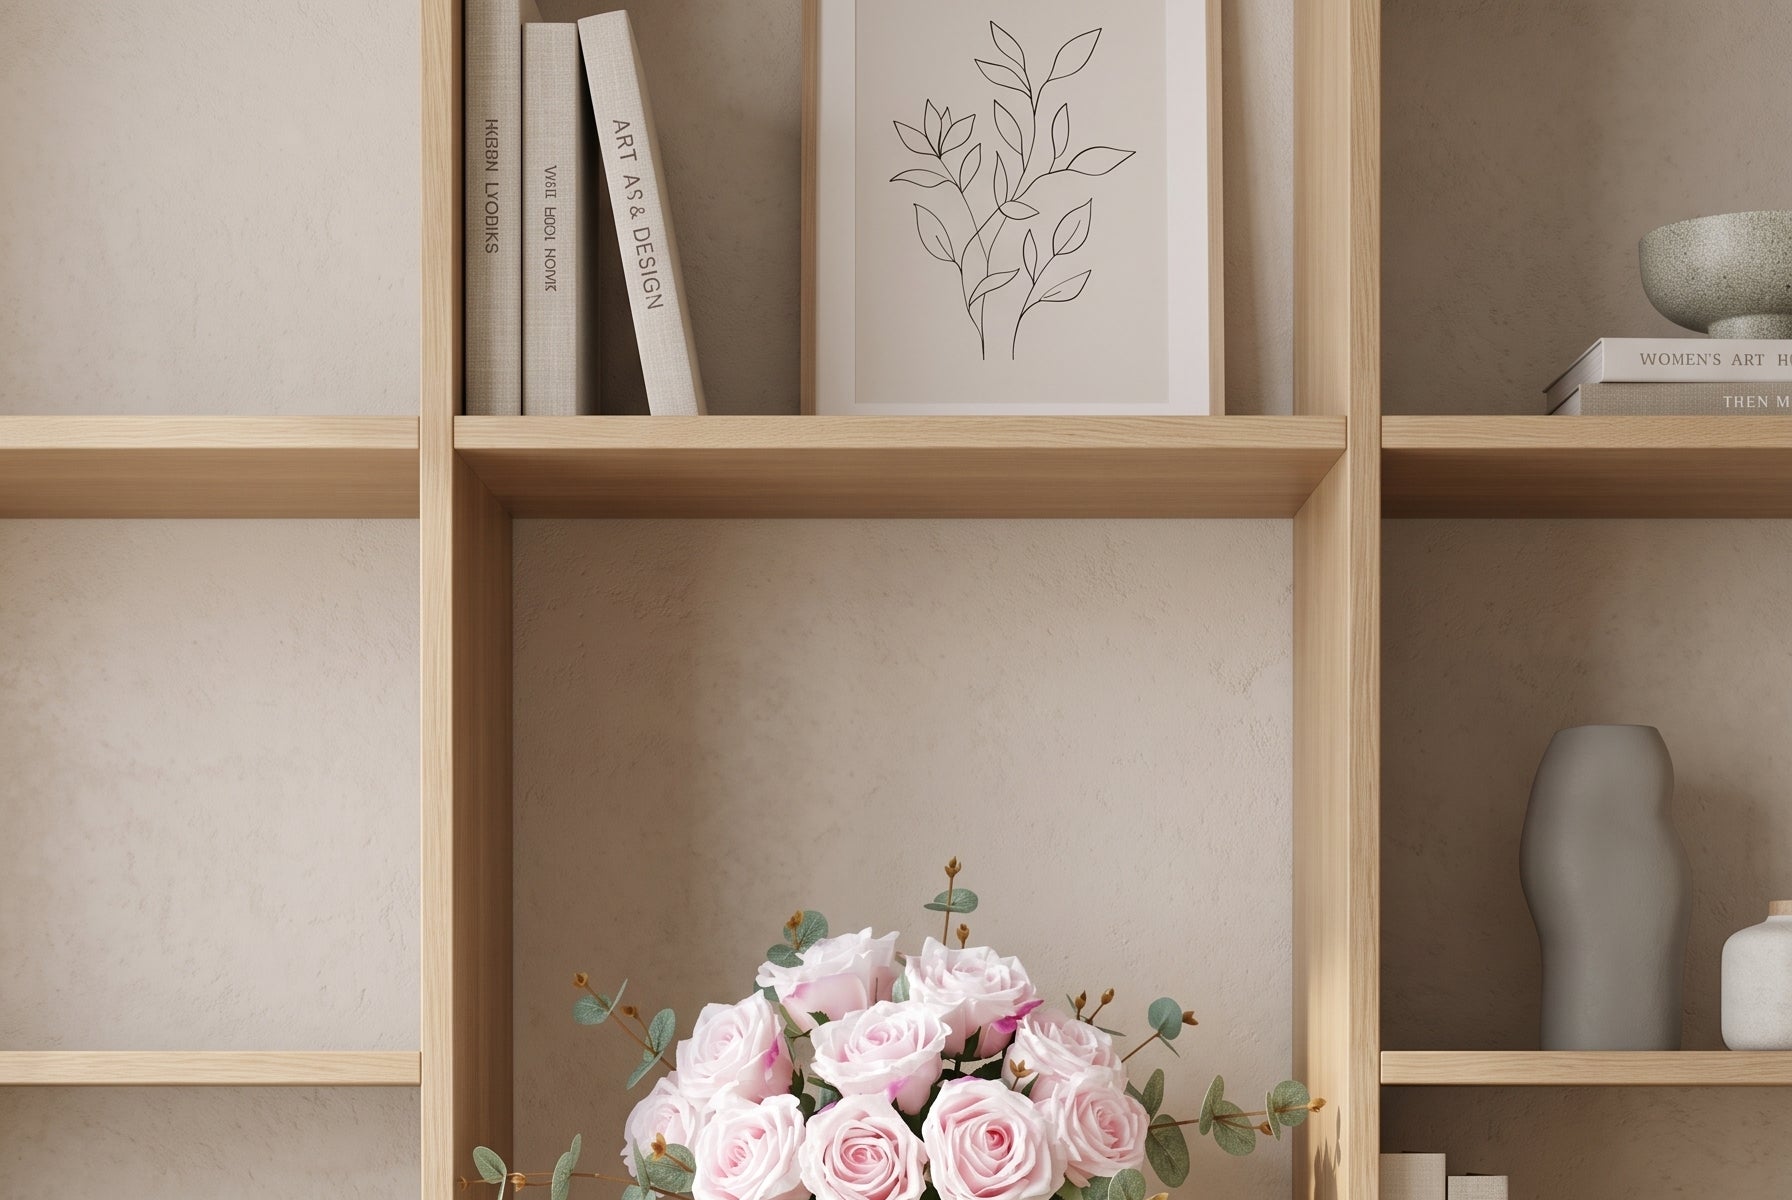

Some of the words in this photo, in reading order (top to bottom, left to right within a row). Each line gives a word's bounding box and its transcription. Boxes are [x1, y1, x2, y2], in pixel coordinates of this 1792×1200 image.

[613, 119, 637, 162] ART
[633, 227, 664, 310] DESIGN
[1640, 353, 1721, 366] WOMEN'S
[1731, 353, 1765, 366] ART
[1778, 353, 1792, 366] H
[1723, 395, 1768, 408] THEN
